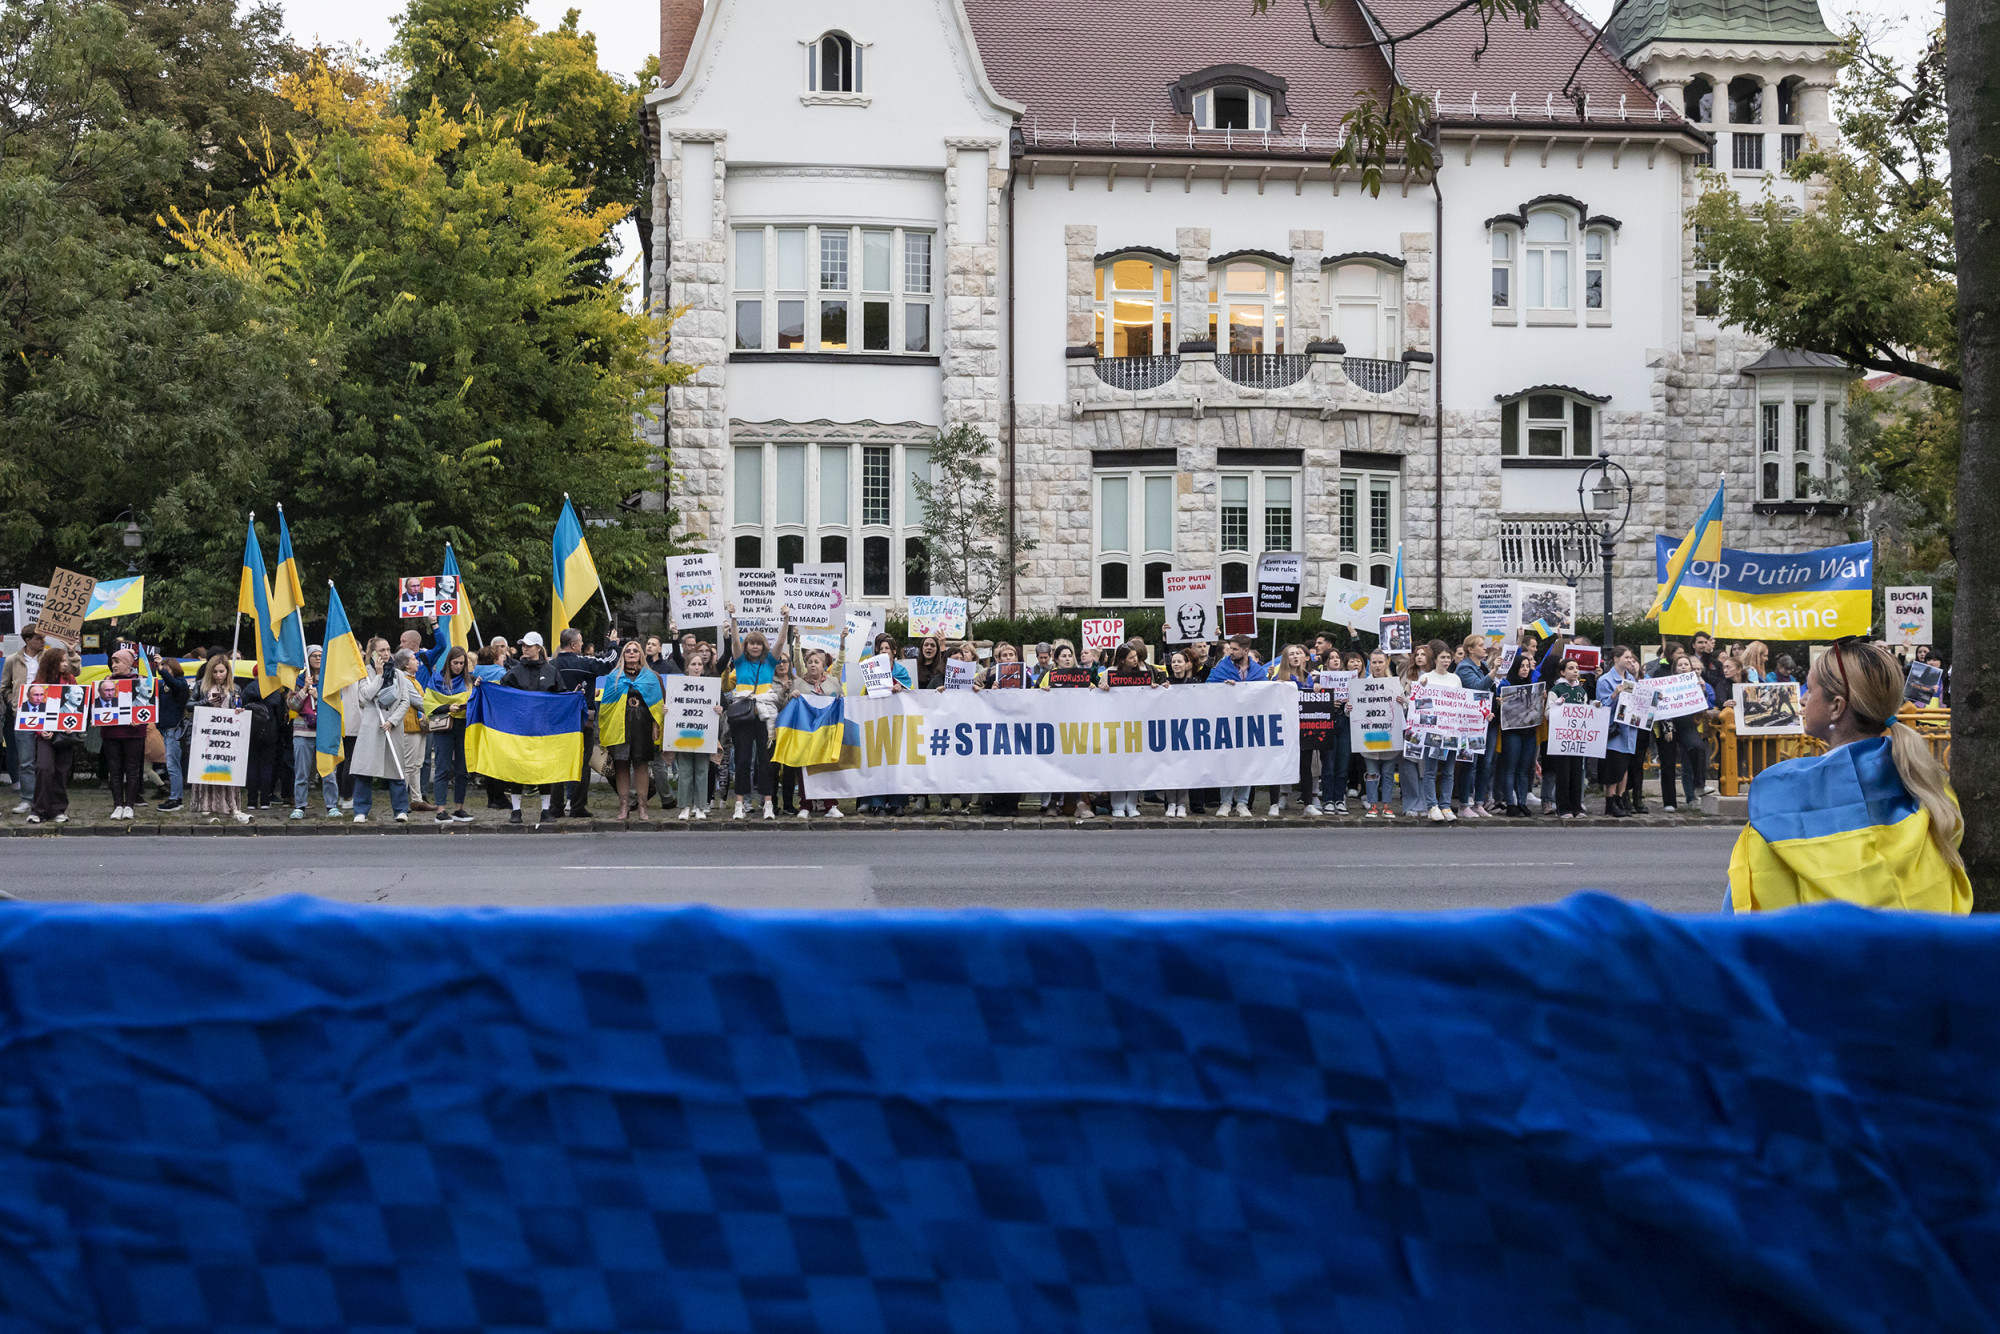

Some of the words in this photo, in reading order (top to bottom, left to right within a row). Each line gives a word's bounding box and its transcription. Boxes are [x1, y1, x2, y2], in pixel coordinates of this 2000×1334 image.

[683, 558, 703, 566] 2014
[1667, 548, 1730, 584] op
[1738, 562, 1811, 585] Putin
[1819, 557, 1870, 580] War
[739, 571, 776, 579] РУССКИЙ
[55, 571, 93, 592] 1849
[738, 579, 777, 587] ВОЕННЫЙ
[680, 583, 713, 596] БУЧА
[52, 585, 90, 605] 1956
[1890, 592, 1928, 601] BUCHA
[687, 599, 707, 607] 2022
[1260, 601, 1292, 609] Convention
[46, 598, 82, 618] 2022
[1895, 606, 1925, 615] БУЧА
[52, 612, 72, 624] NEM
[1728, 602, 1838, 628] Ukraine
[1083, 620, 1123, 635] STOP
[683, 683, 705, 692] 2014
[866, 680, 882, 688] STATE
[1364, 683, 1385, 691] 2014
[682, 709, 704, 717] 2022
[1562, 706, 1594, 719] RUSSIA
[210, 715, 233, 724] 2014
[1567, 719, 1577, 729] IS
[1581, 721, 1587, 729] A
[1555, 728, 1600, 742] TERRORIST
[208, 740, 231, 749] 2022
[864, 714, 927, 769] WE
[1560, 740, 1586, 754] STATE
